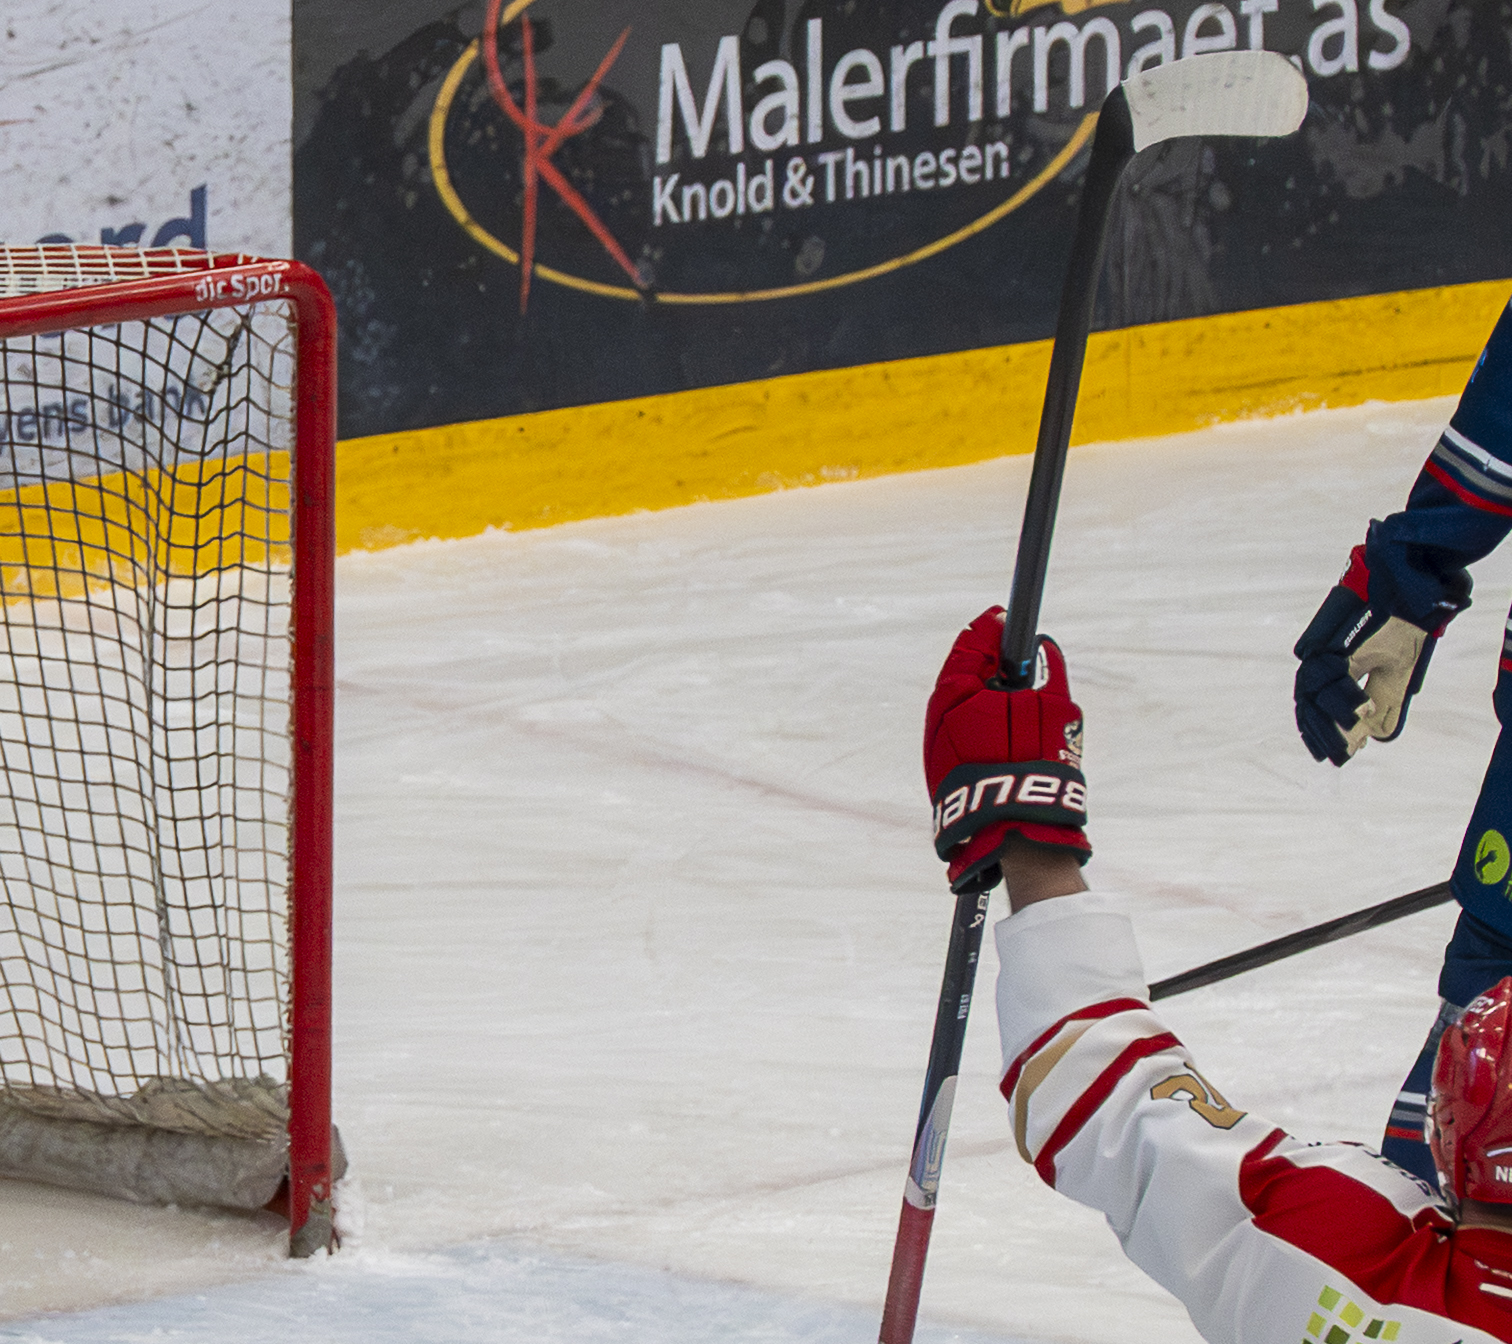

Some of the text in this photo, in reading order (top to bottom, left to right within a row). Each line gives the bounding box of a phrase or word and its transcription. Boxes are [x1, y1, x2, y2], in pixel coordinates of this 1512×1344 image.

[652, 137, 1010, 227] Knold & Thinesen
